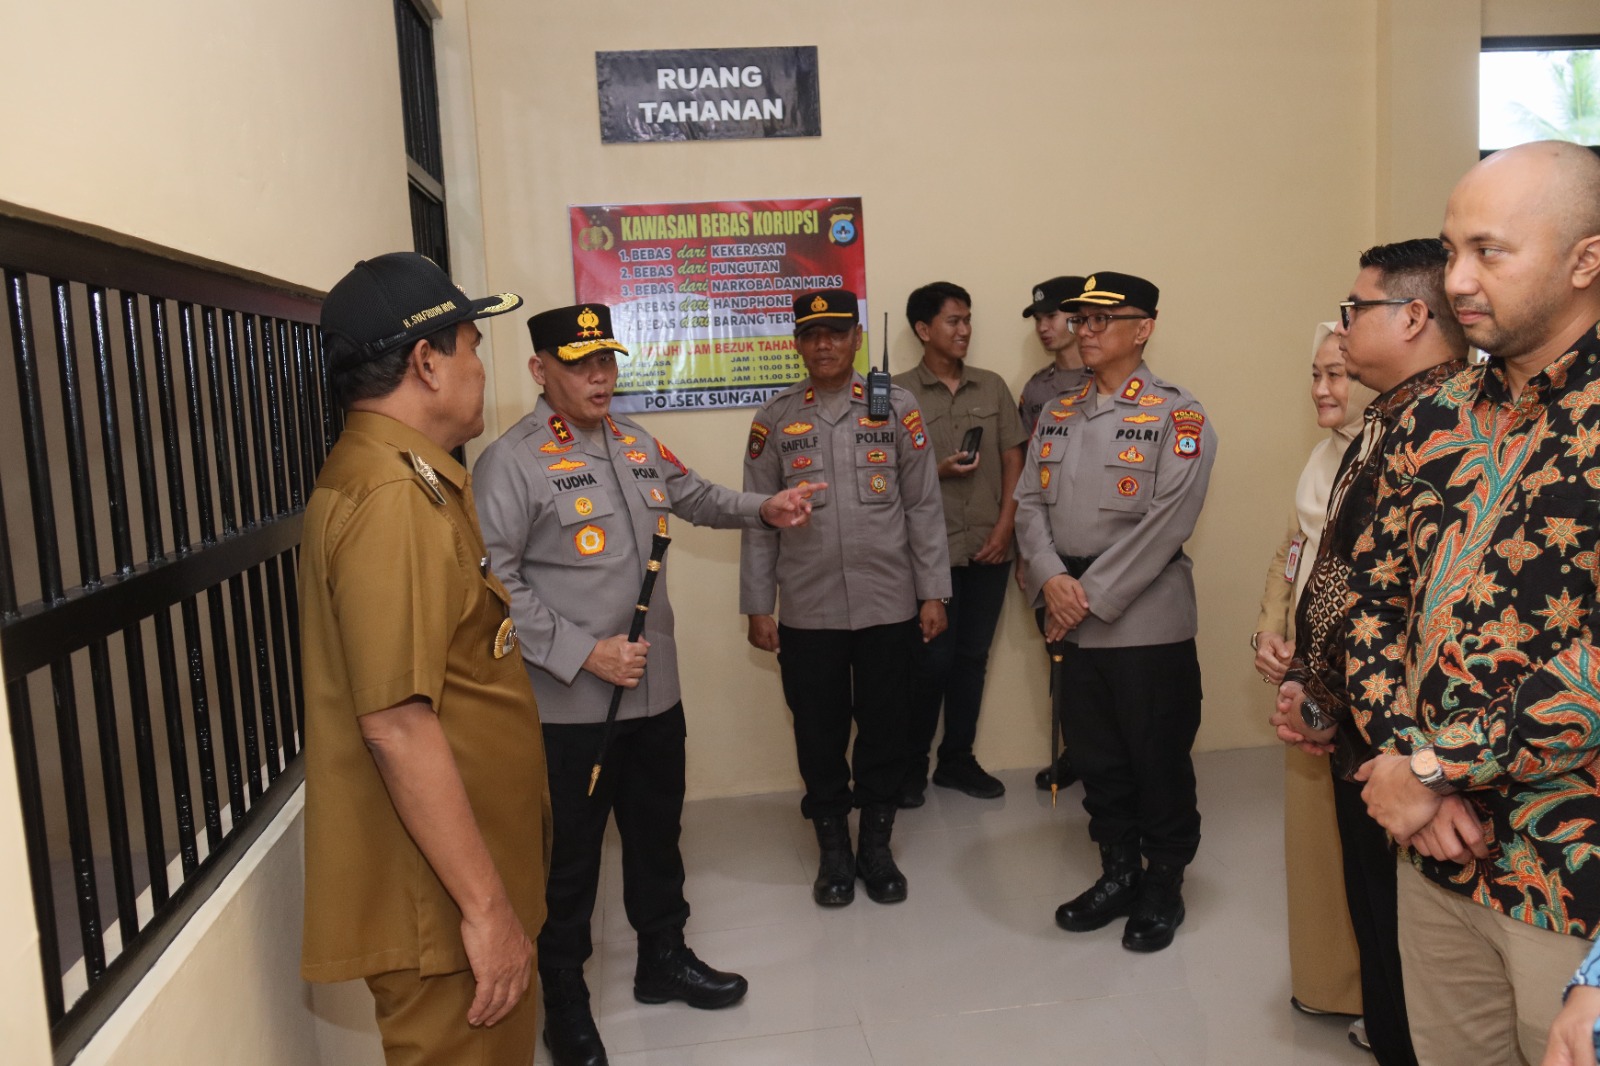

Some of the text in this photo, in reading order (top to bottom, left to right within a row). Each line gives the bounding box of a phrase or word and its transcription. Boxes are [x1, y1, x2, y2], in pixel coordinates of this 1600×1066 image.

[657, 66, 762, 90] RUANG
[638, 98, 784, 124] TAHANAN
[620, 209, 819, 241] KAWASAN BEBAS KORUPSI
[631, 247, 672, 261] BEBAS
[676, 243, 707, 259] dari
[711, 243, 786, 258] KEKERASAN
[633, 265, 674, 279] BEBAS
[678, 260, 708, 275] dari
[710, 261, 780, 276] PUNGUTAN
[635, 282, 676, 297] BEBAS
[678, 278, 709, 293] dari
[711, 277, 772, 292] NARKOBA
[774, 276, 801, 290] DAN
[803, 275, 843, 289] MIRAS
[636, 301, 676, 313] BEBAS
[679, 296, 710, 312] dari
[713, 294, 792, 310] HANDPHONE
[713, 314, 765, 327] BARANG
[714, 341, 755, 355] BEZUK
[730, 355, 750, 363] JAM
[758, 353, 782, 361] 10.00
[731, 365, 751, 373] JAM
[758, 363, 783, 371] 10.00
[667, 376, 727, 387] KEAGAMAAN
[731, 374, 751, 382] JAM
[759, 373, 783, 381] 11.00
[645, 392, 705, 409] POLSEK
[708, 389, 767, 407] SUNGAI
[855, 431, 895, 444] POLRI
[1115, 428, 1159, 443] POLRI
[552, 472, 598, 492] YUDHA
[631, 467, 660, 480] POLRI
